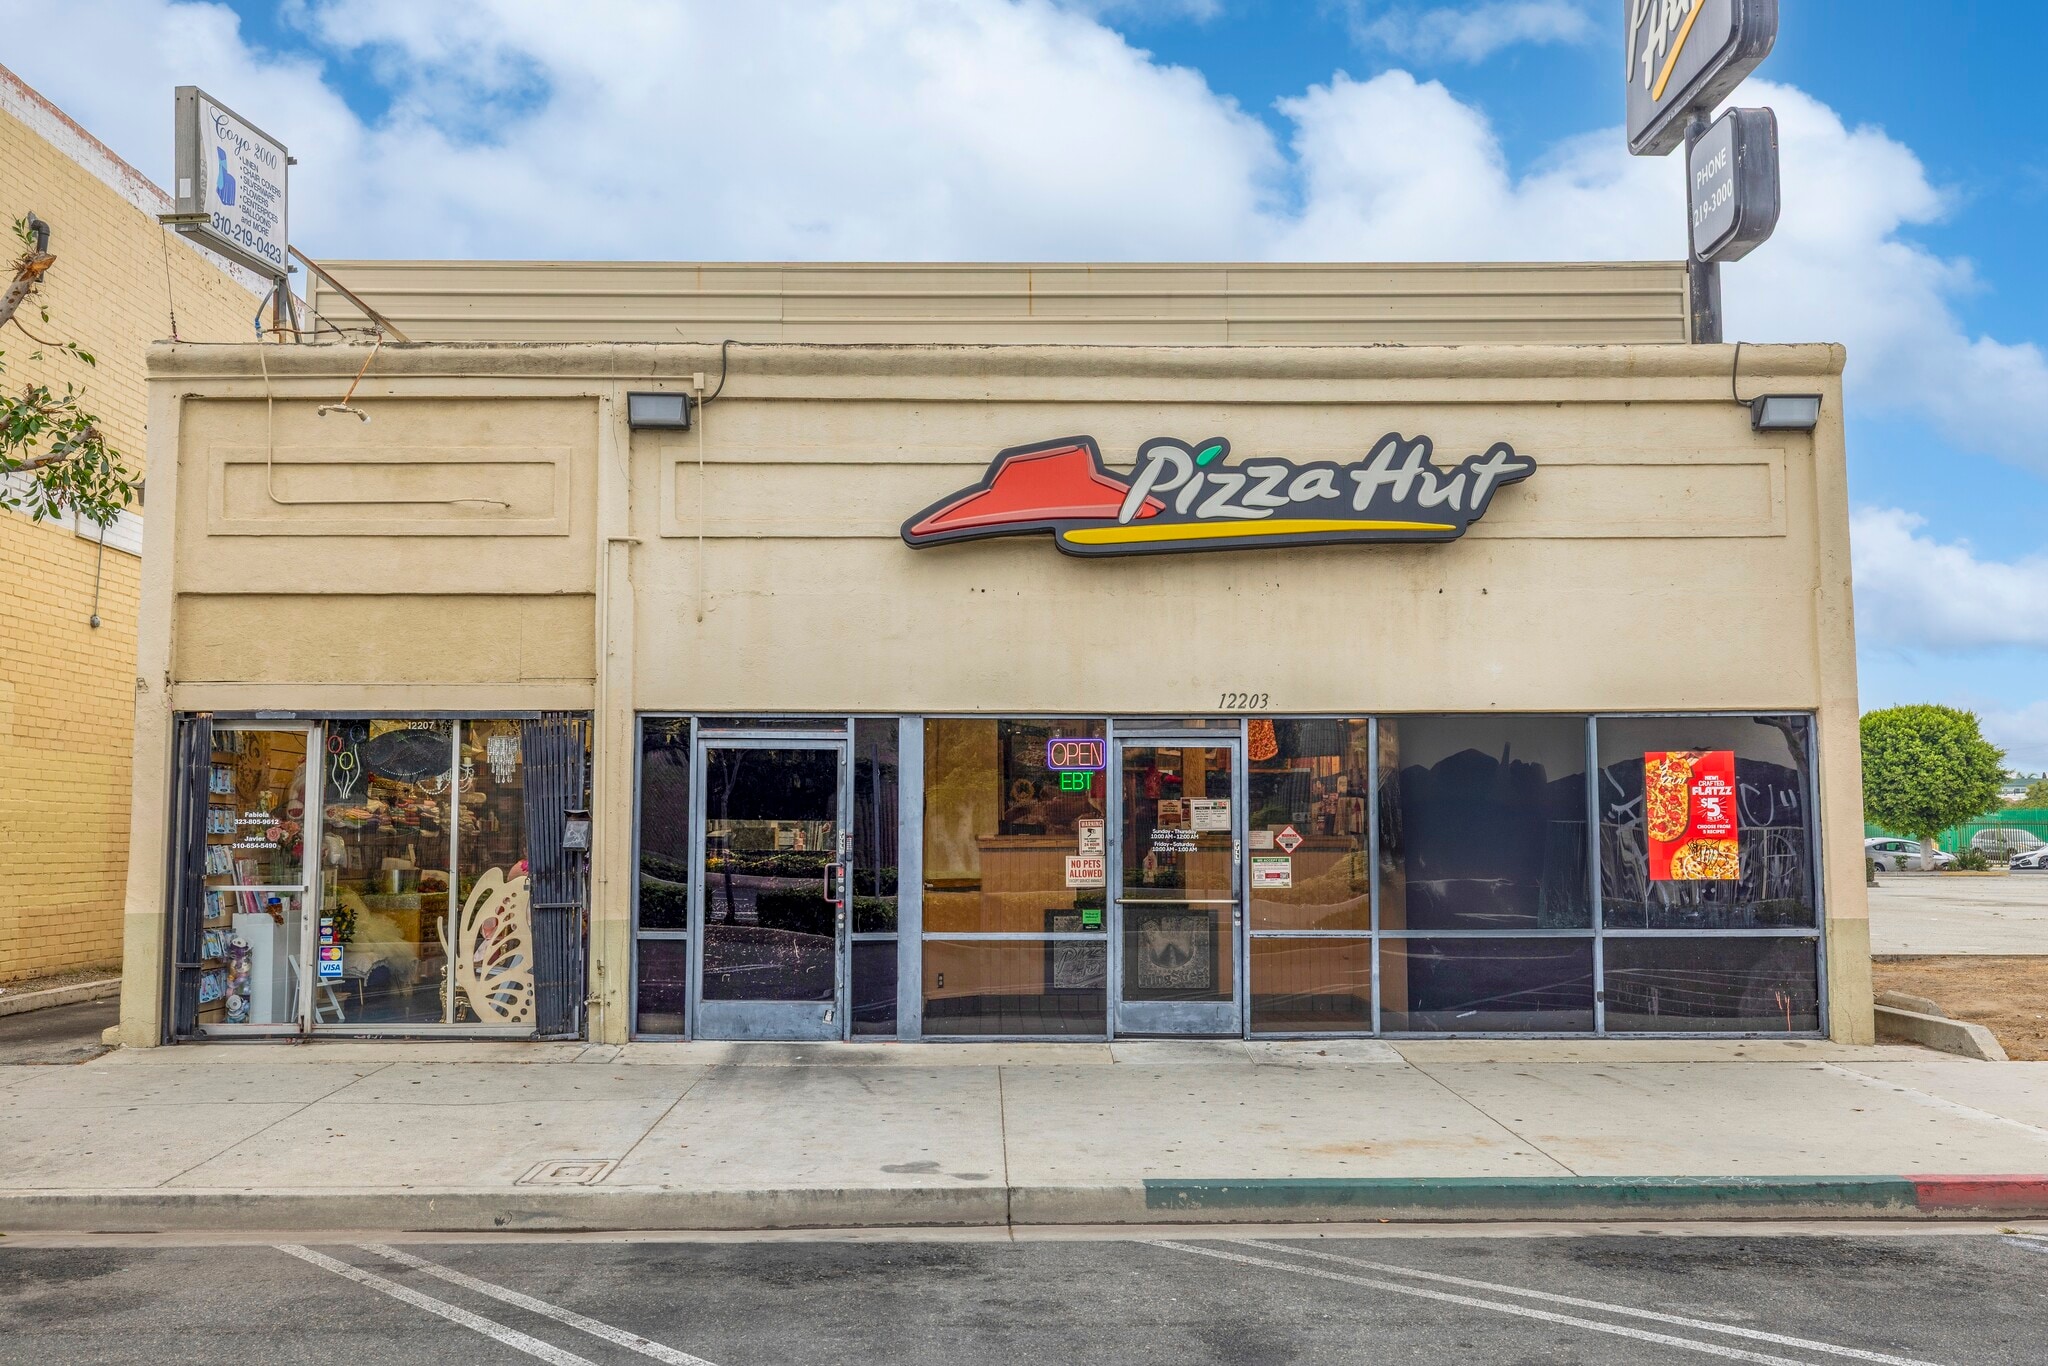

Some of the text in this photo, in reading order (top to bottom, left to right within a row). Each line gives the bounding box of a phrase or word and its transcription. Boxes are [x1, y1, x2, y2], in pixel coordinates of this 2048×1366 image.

[210, 106, 277, 170] Coyo 2000
[242, 157, 259, 173] LINEN
[1696, 147, 1727, 190] PHONE
[242, 166, 282, 198] CHAIR COVERS
[243, 175, 275, 203] SILVERWARE
[242, 186, 269, 208] FLOWERS
[1693, 178, 1733, 228] 219-3000
[240, 216, 269, 237] and MORE
[241, 205, 272, 229] BALLOONS
[212, 211, 282, 264] 310-219-0423
[1118, 440, 1529, 525] Pizza Hut
[1218, 692, 1269, 709] 12203
[408, 721, 435, 730] 12207
[1051, 742, 1103, 766] OPEN
[1061, 772, 1094, 790] EBT
[1692, 786, 1733, 795] FLATZZ
[1701, 797, 1720, 817] $5
[1070, 870, 1103, 878] ALLOWED
[1071, 860, 1101, 868] NO PETS
